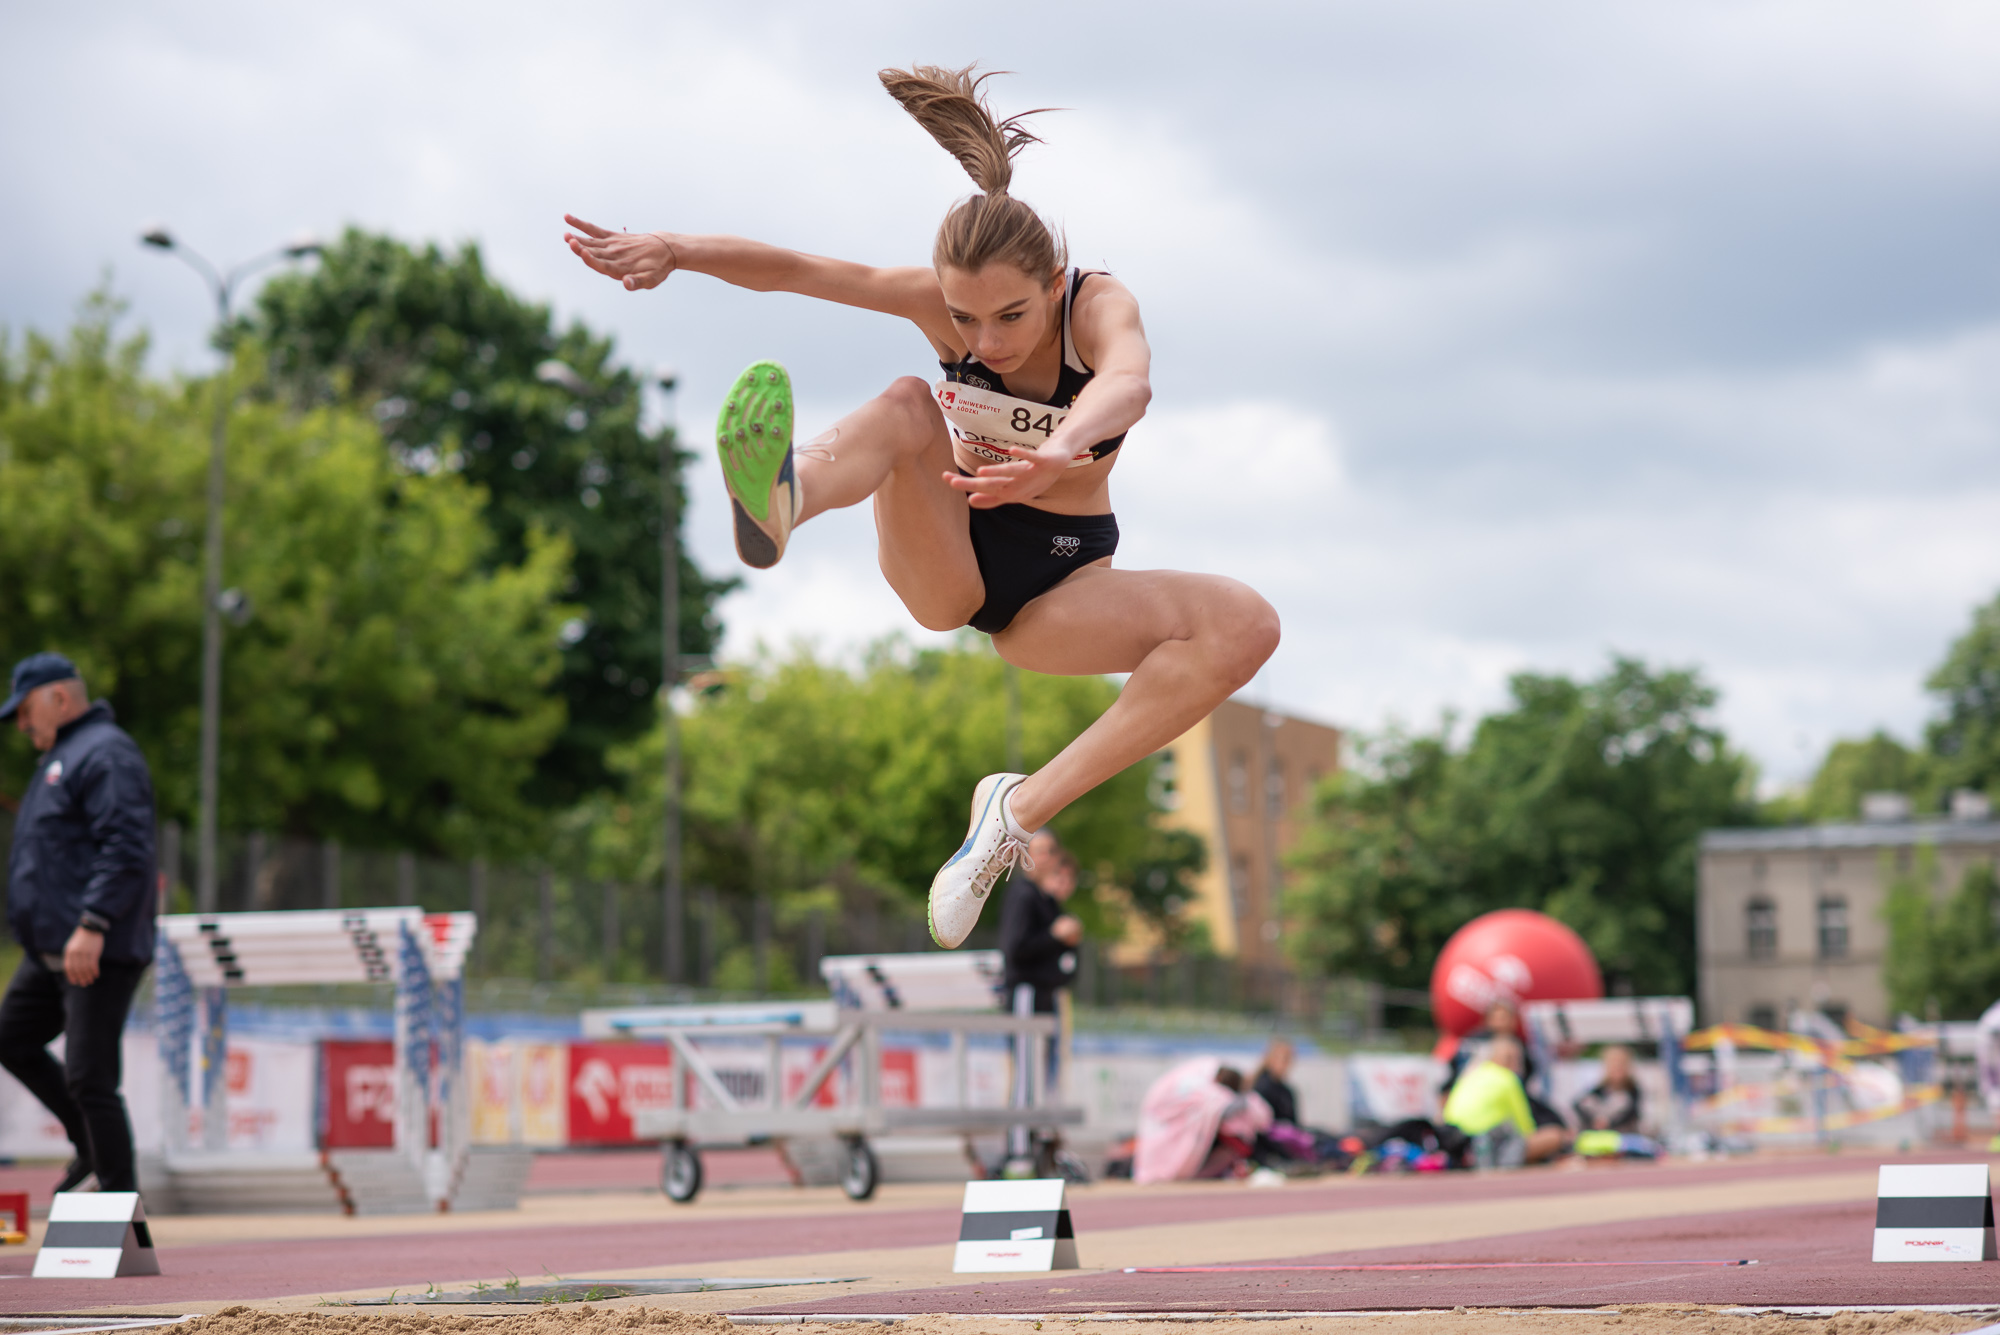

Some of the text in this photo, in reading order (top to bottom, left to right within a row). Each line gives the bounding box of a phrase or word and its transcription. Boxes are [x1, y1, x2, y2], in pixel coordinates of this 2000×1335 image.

[957, 406, 979, 415] ŁÓDZKI
[958, 399, 1001, 413] UNIWERSYTET
[1010, 407, 1066, 438] 84
